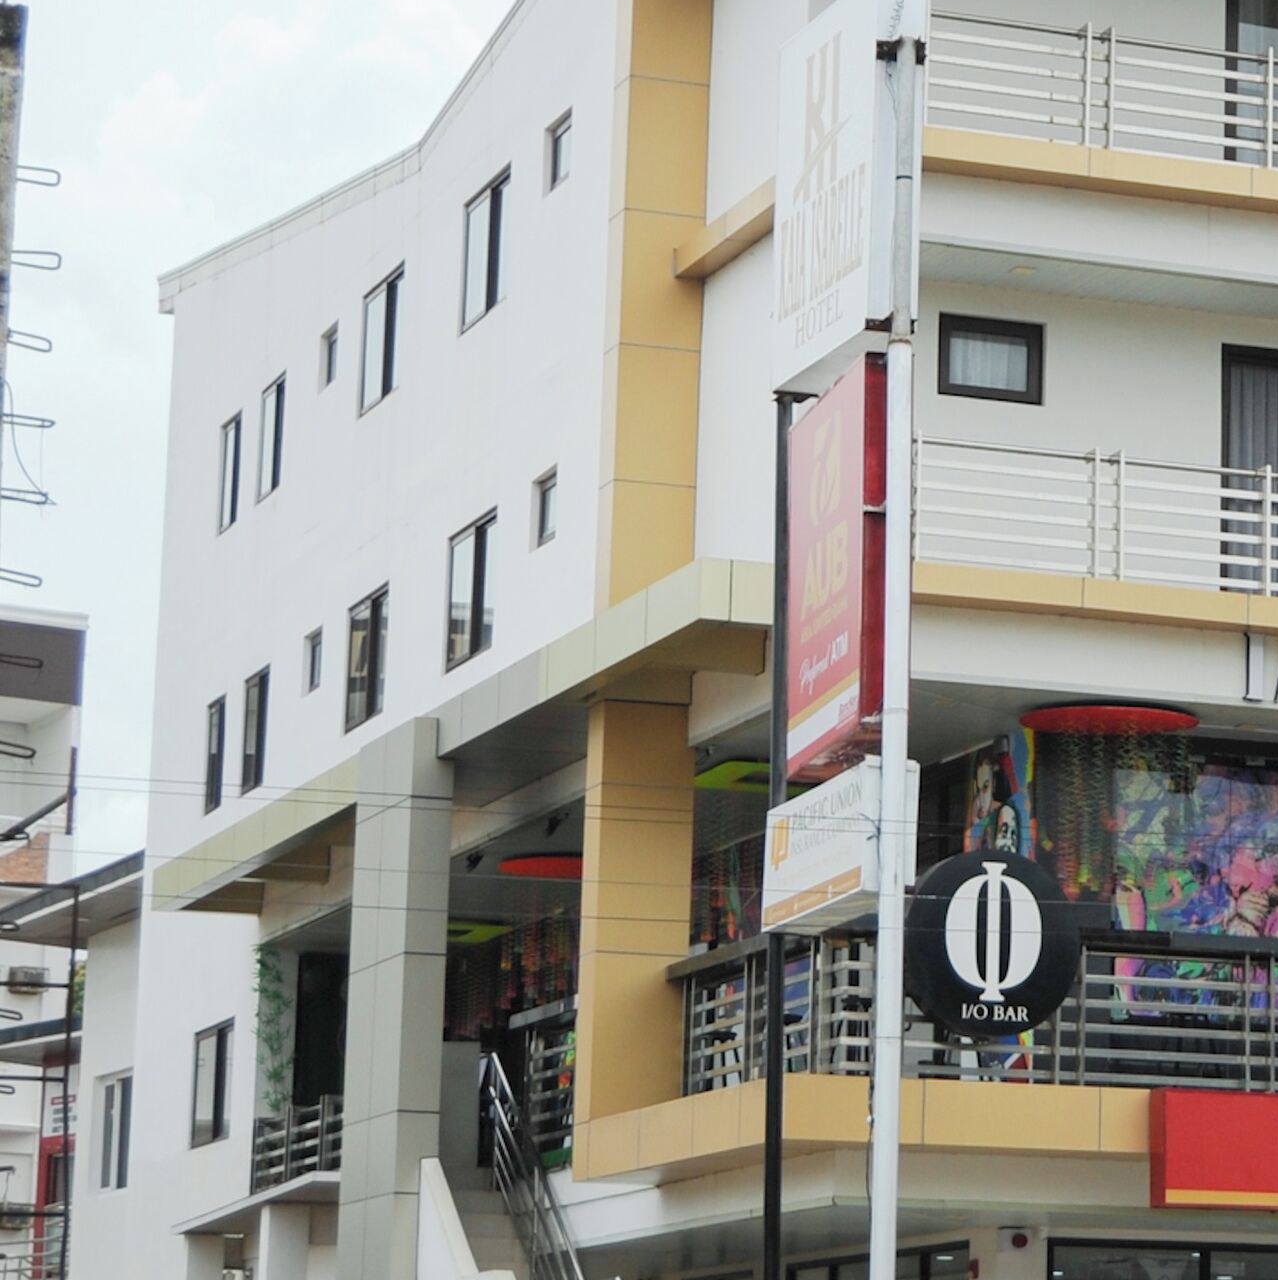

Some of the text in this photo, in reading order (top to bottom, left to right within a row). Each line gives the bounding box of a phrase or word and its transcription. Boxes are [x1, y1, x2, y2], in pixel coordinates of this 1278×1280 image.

[794, 287, 845, 349] HOTEL
[800, 519, 849, 623] AUB
[830, 631, 849, 667] ATM
[830, 776, 864, 816] UNION
[961, 1003, 1029, 1022] I/O BAR
